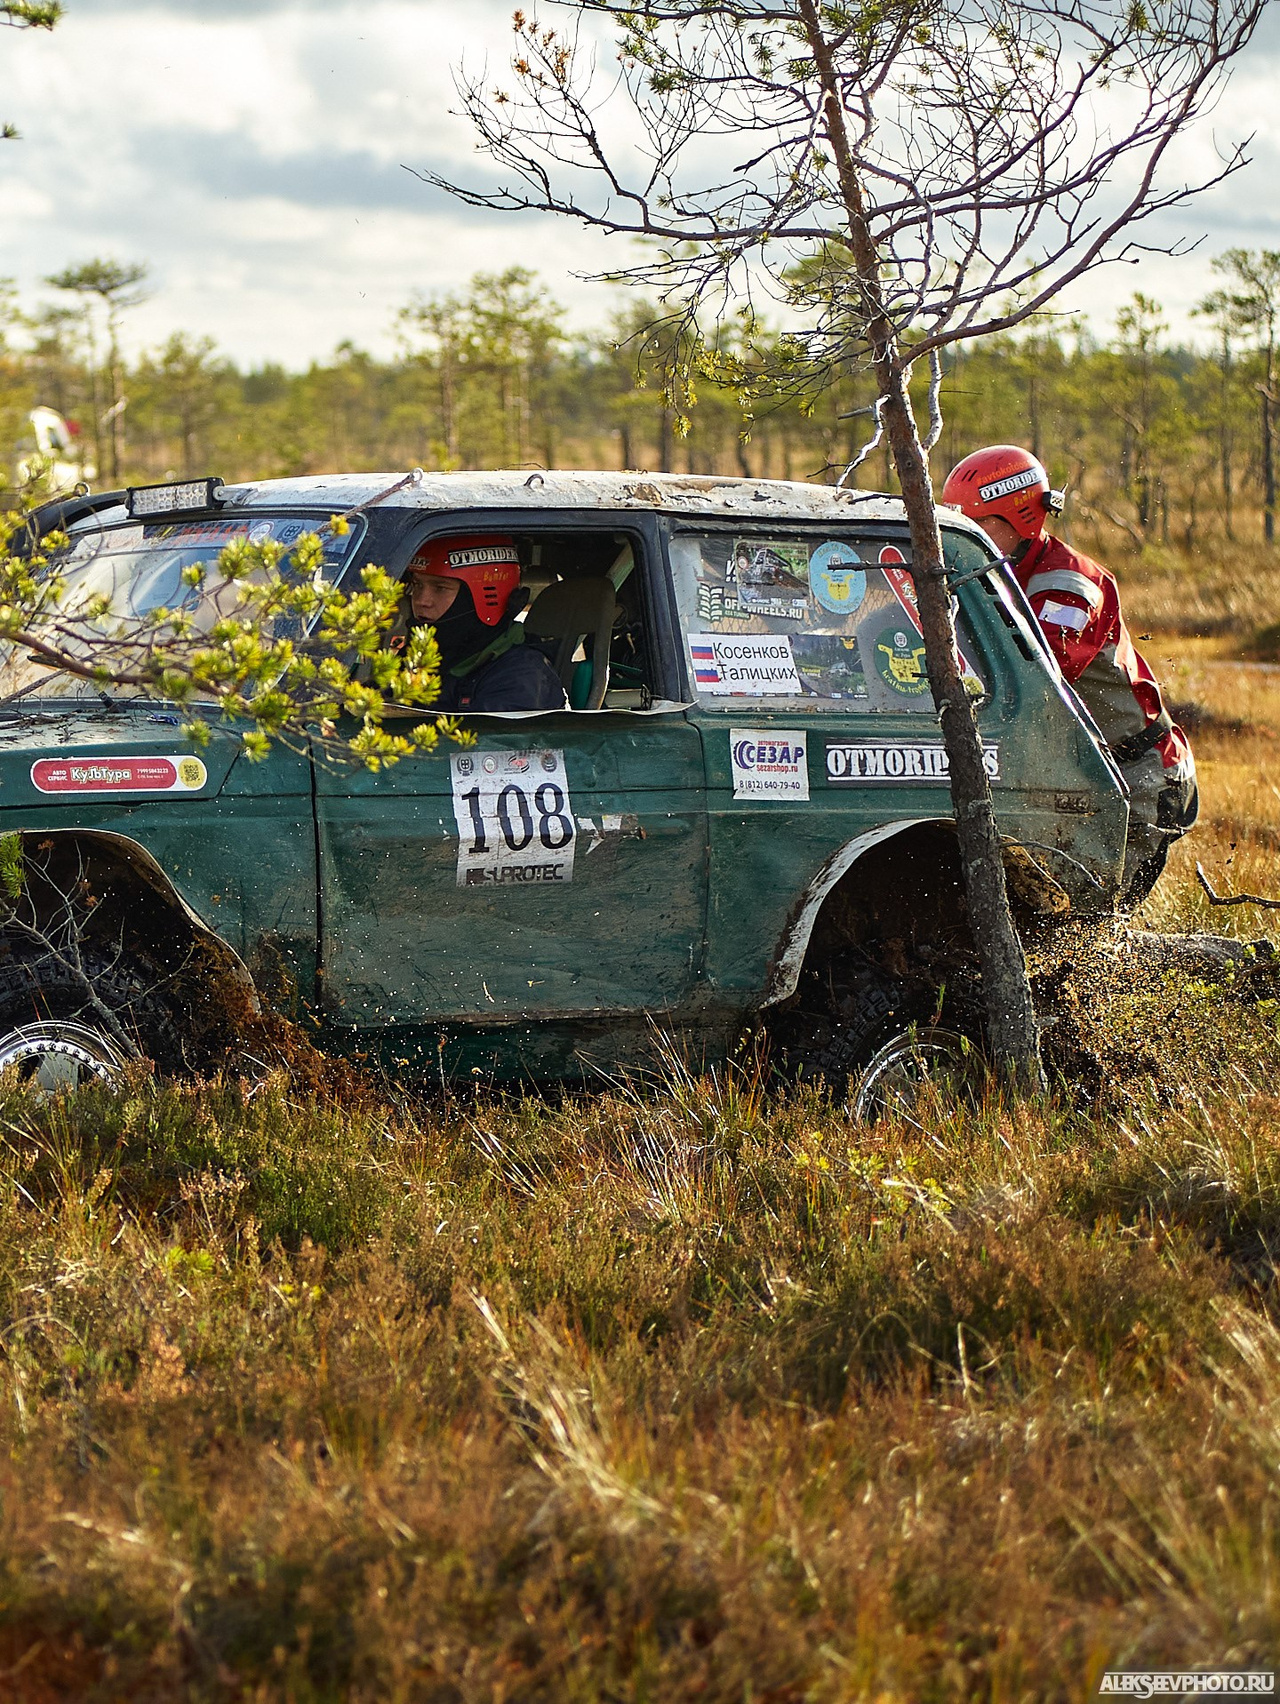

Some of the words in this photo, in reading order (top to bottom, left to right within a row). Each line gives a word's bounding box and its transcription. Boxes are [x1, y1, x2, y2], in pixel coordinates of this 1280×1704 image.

[713, 642, 789, 659] Косенков
[746, 745, 805, 764] СЕЗАР
[826, 749, 999, 776] OTMORIDS
[756, 764, 799, 775] sezarshop.ru
[739, 780, 744, 788] 8
[745, 780, 763, 789] (812)
[764, 780, 801, 790] 640-79-40
[461, 782, 574, 854] 108
